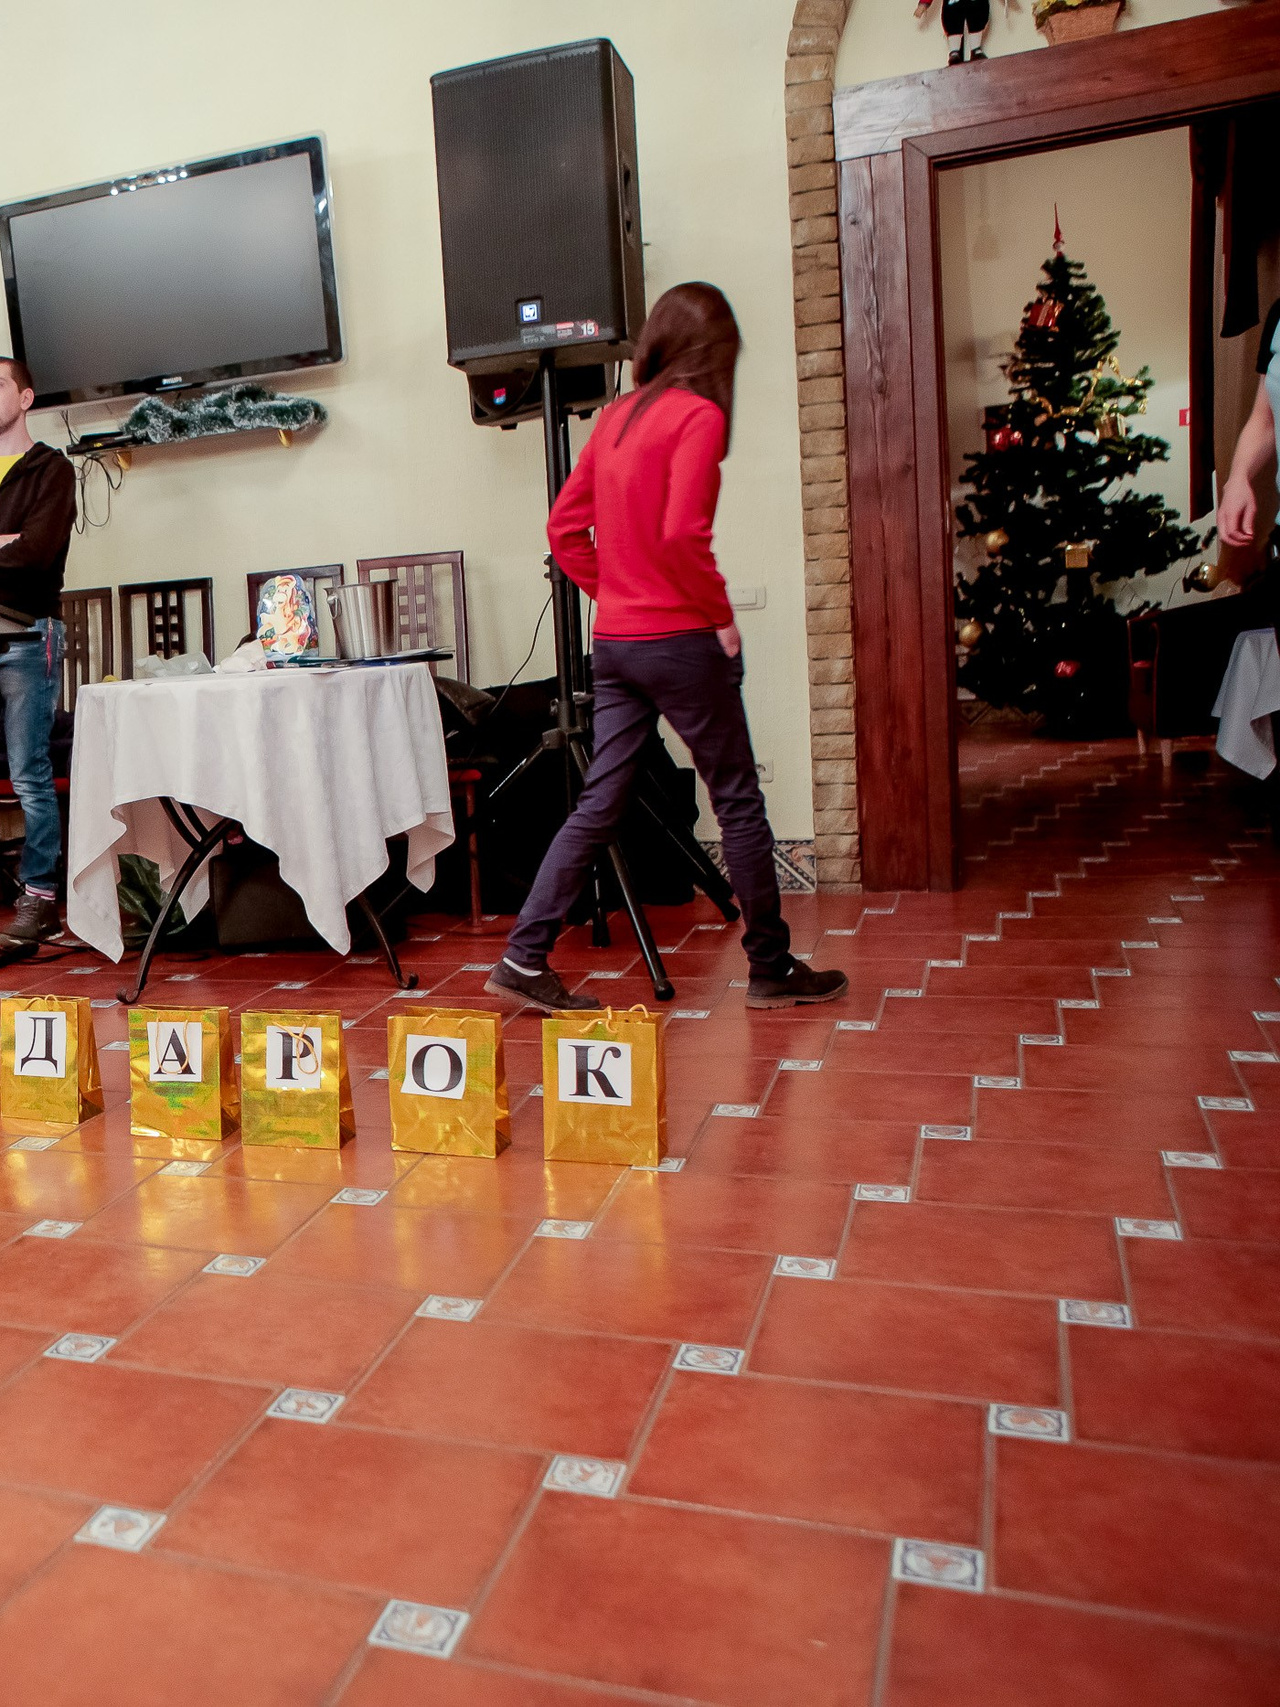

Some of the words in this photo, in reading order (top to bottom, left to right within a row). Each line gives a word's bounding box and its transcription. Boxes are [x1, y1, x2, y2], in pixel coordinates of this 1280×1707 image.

[581, 322, 595, 336] 15
[21, 1016, 58, 1074] Д
[153, 1027, 197, 1075] А
[276, 1031, 317, 1080] Р
[412, 1043, 463, 1093] О
[568, 1044, 624, 1099] К
